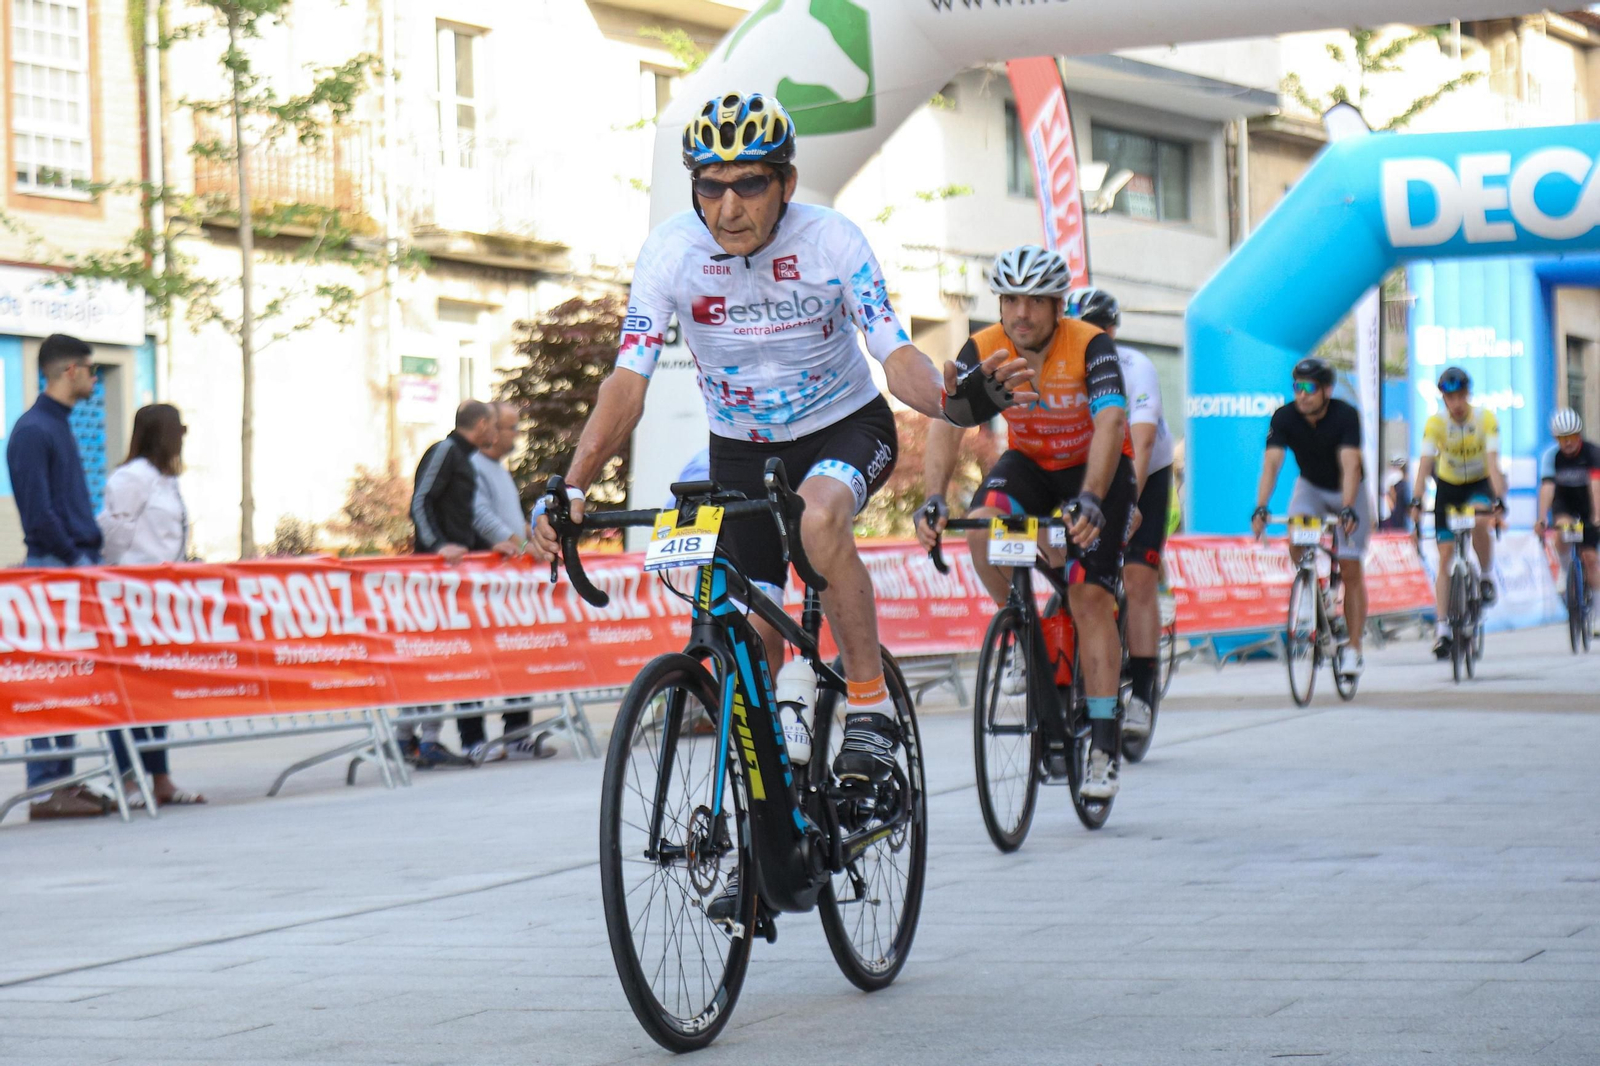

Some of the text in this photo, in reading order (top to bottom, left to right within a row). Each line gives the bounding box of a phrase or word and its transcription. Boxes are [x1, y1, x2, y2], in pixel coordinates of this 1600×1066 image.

[1381, 146, 1600, 247] DEC
[703, 264, 732, 275] GOBIK
[660, 537, 702, 554] 418
[1002, 543, 1025, 555] 49
[0, 580, 99, 653] OIZ
[97, 577, 240, 648] FROIZ
[237, 571, 367, 641] FROIZ
[364, 571, 471, 634] FROIZ
[469, 570, 566, 629] FROIZ
